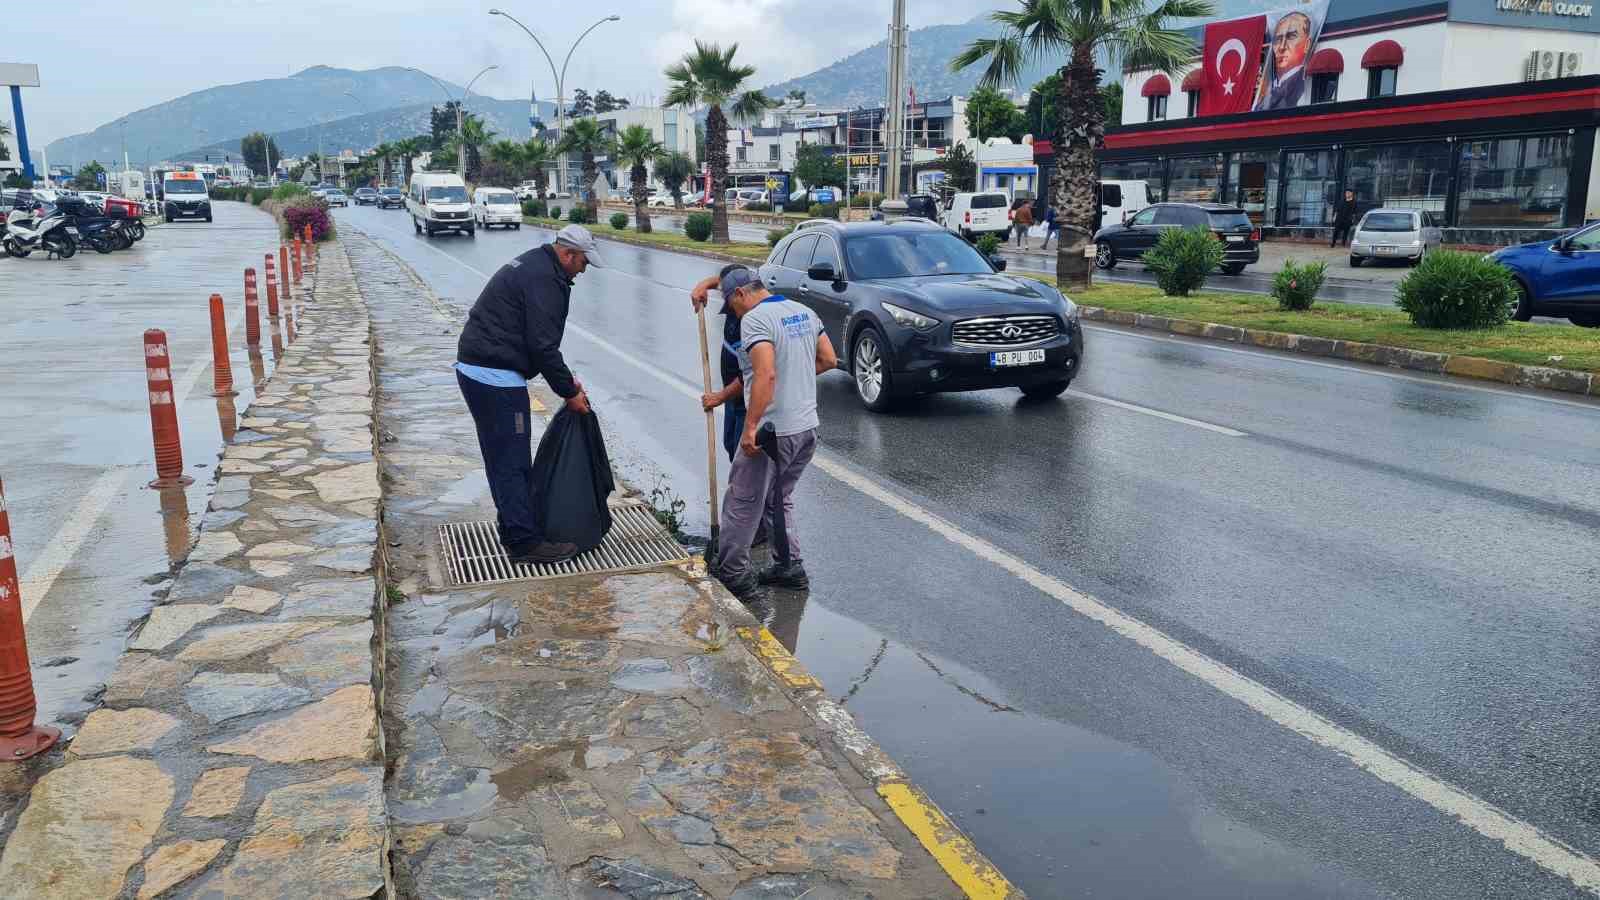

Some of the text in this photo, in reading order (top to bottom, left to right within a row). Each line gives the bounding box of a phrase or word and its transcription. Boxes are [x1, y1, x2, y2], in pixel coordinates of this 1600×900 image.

[996, 350, 1043, 364] 48 PU 004
